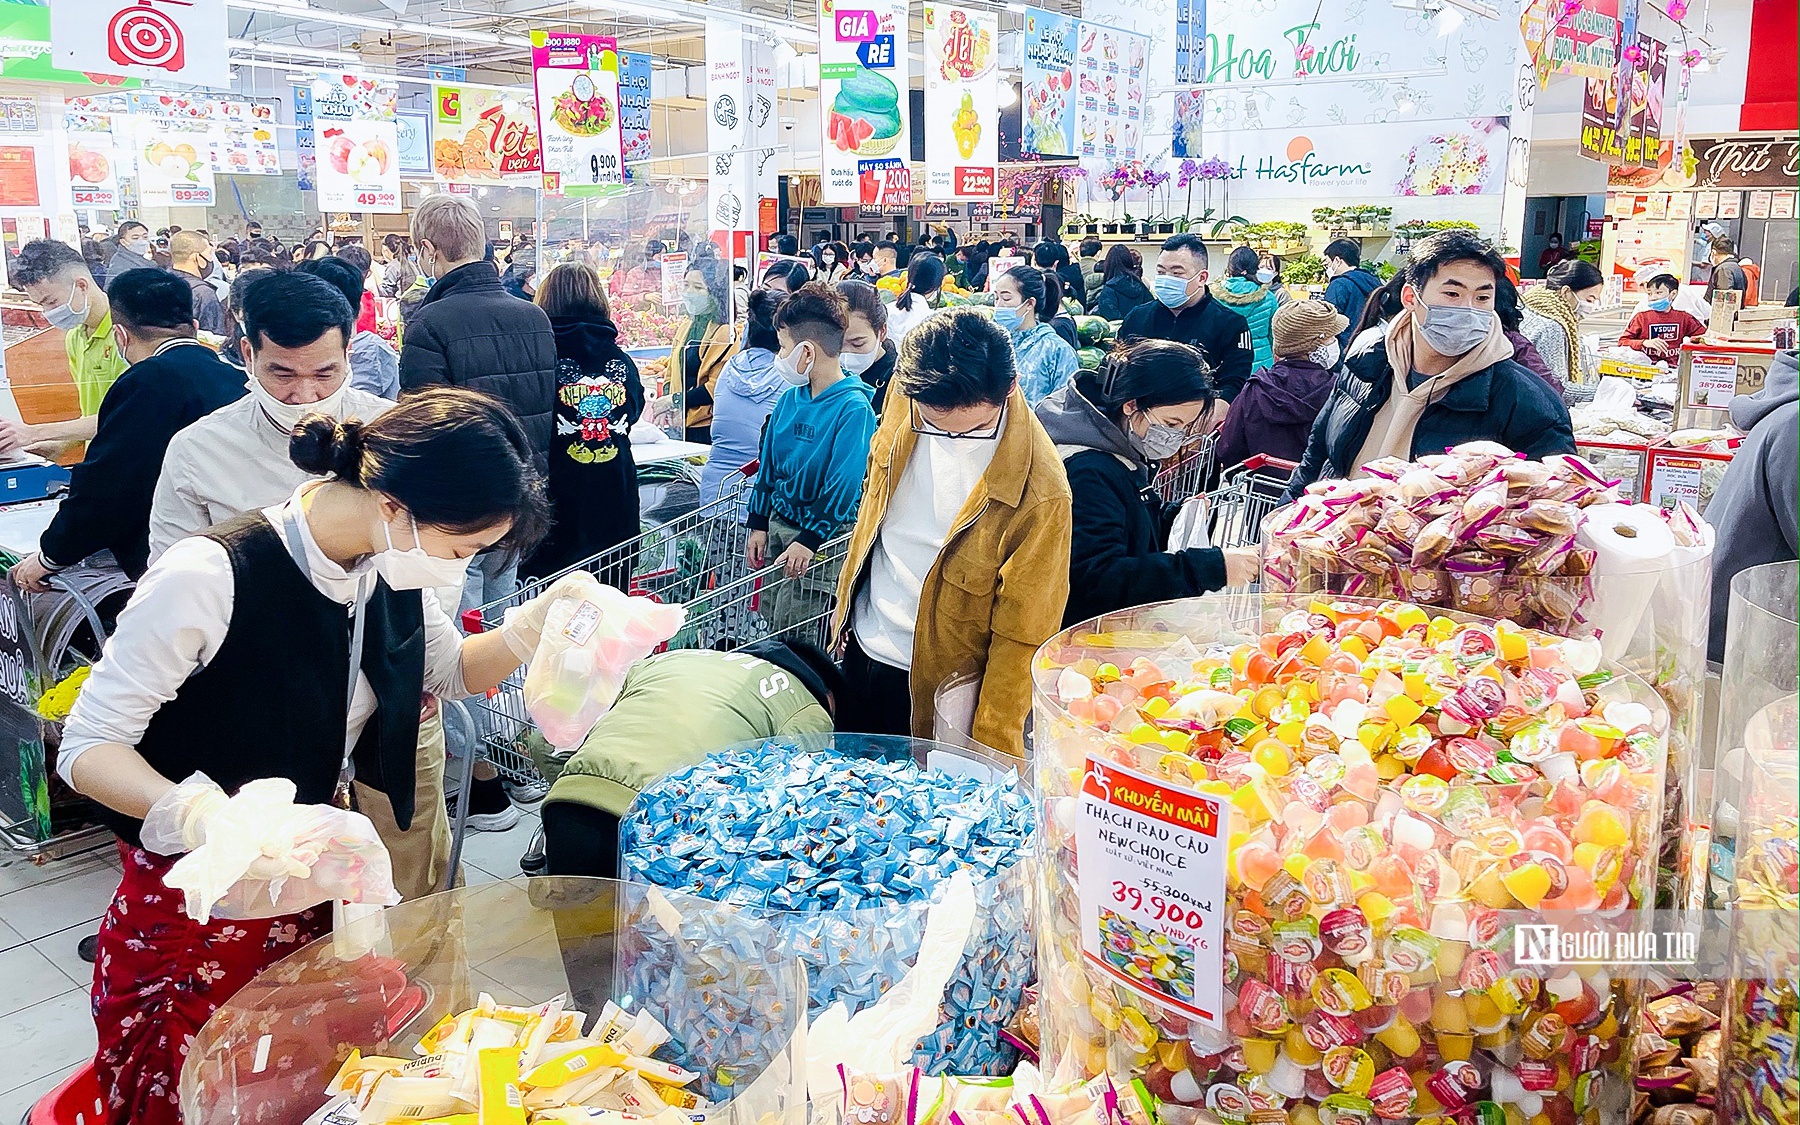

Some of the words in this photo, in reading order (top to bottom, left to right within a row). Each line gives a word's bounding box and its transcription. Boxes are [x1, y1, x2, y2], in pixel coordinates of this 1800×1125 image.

[839, 12, 869, 38] GIÁ
[544, 38, 561, 46] 1900
[868, 36, 890, 64] RẺ
[1206, 33, 1276, 83] Hoa
[632, 76, 648, 91] HỘI
[1256, 152, 1371, 184] Hasfarm
[1704, 141, 1771, 177] Thịt
[962, 176, 991, 192] 22.900
[1114, 786, 1174, 817] KHUYẾN
[1176, 807, 1210, 828] MÃI
[1085, 802, 1132, 830] THẠCH
[1137, 822, 1169, 842] RAU
[1098, 828, 1187, 869] NEWCHOICE
[1156, 867, 1174, 878] NAM
[1112, 880, 1203, 930] 39.900
[1160, 924, 1208, 950] VNĐ/KG
[403, 1054, 442, 1071] DURIAN
